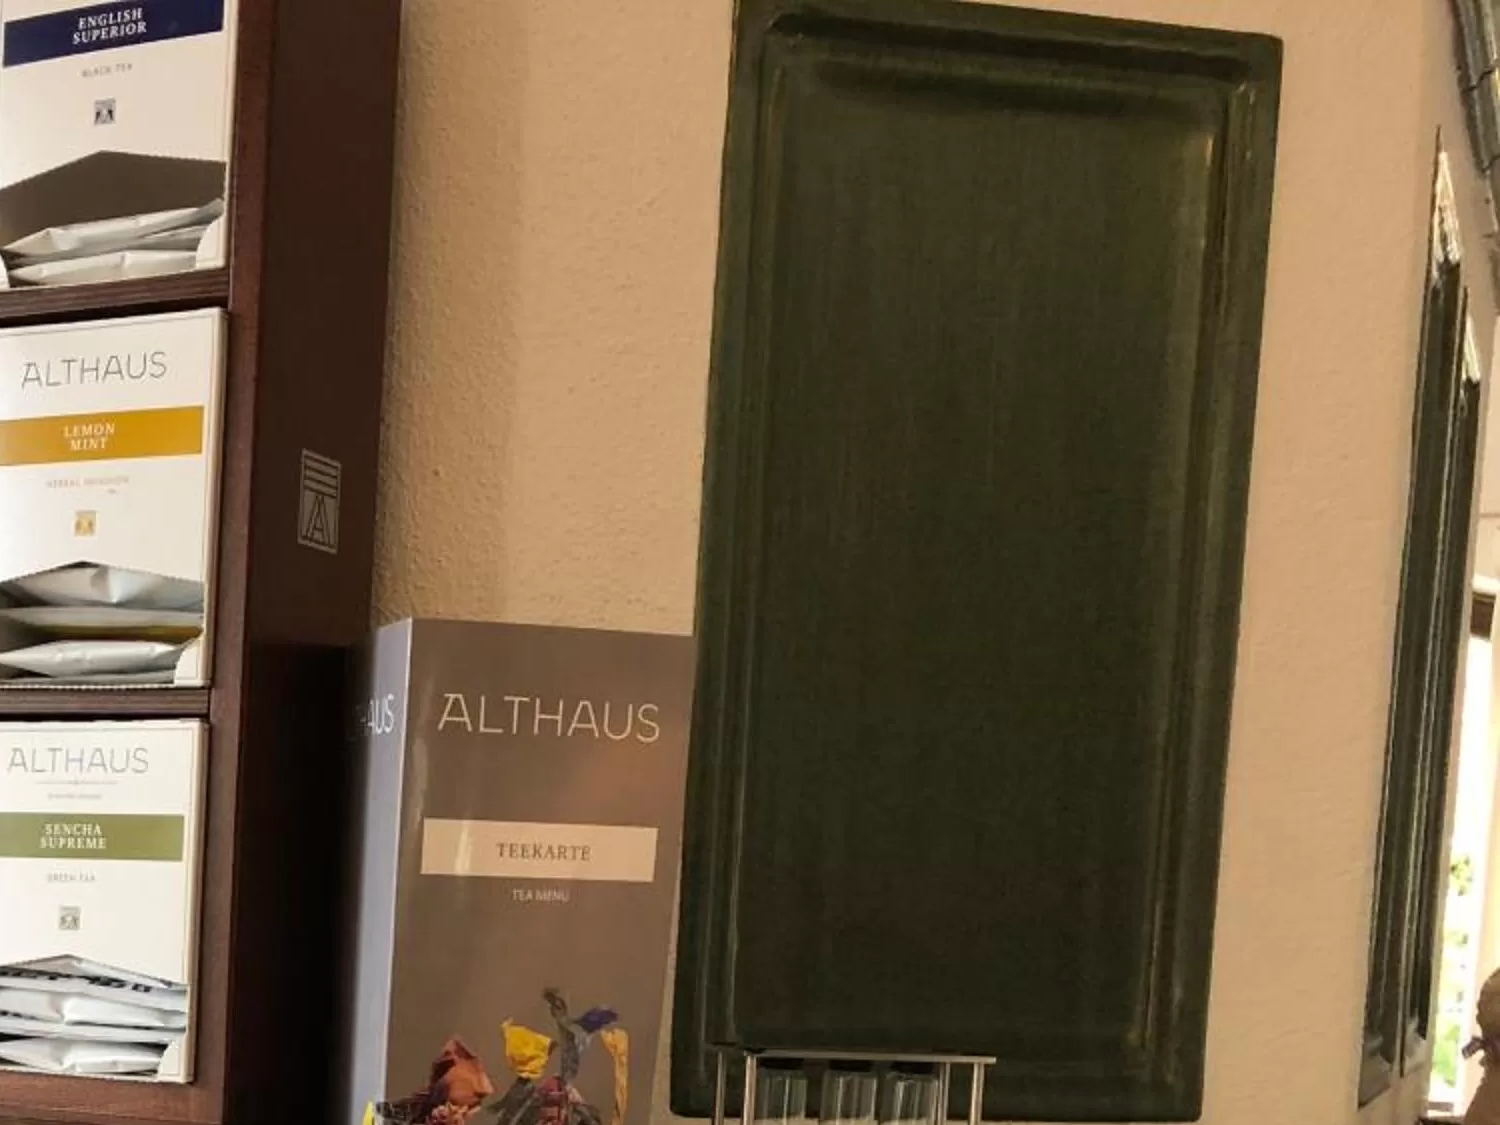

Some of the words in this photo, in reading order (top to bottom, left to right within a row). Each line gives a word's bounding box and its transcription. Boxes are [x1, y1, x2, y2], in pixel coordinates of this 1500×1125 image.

[78, 8, 143, 30] ENGLISH
[72, 21, 148, 45] SUPERIOR
[22, 351, 168, 390] ALTHAUS
[64, 423, 115, 438] LEMON
[70, 438, 108, 451] MINT
[436, 693, 661, 742] ALTHAUS
[6, 747, 150, 775] ALTHAUS
[43, 823, 102, 836] SENCHA
[39, 836, 108, 850] SUPREME
[496, 842, 592, 861] TEEKARTE
